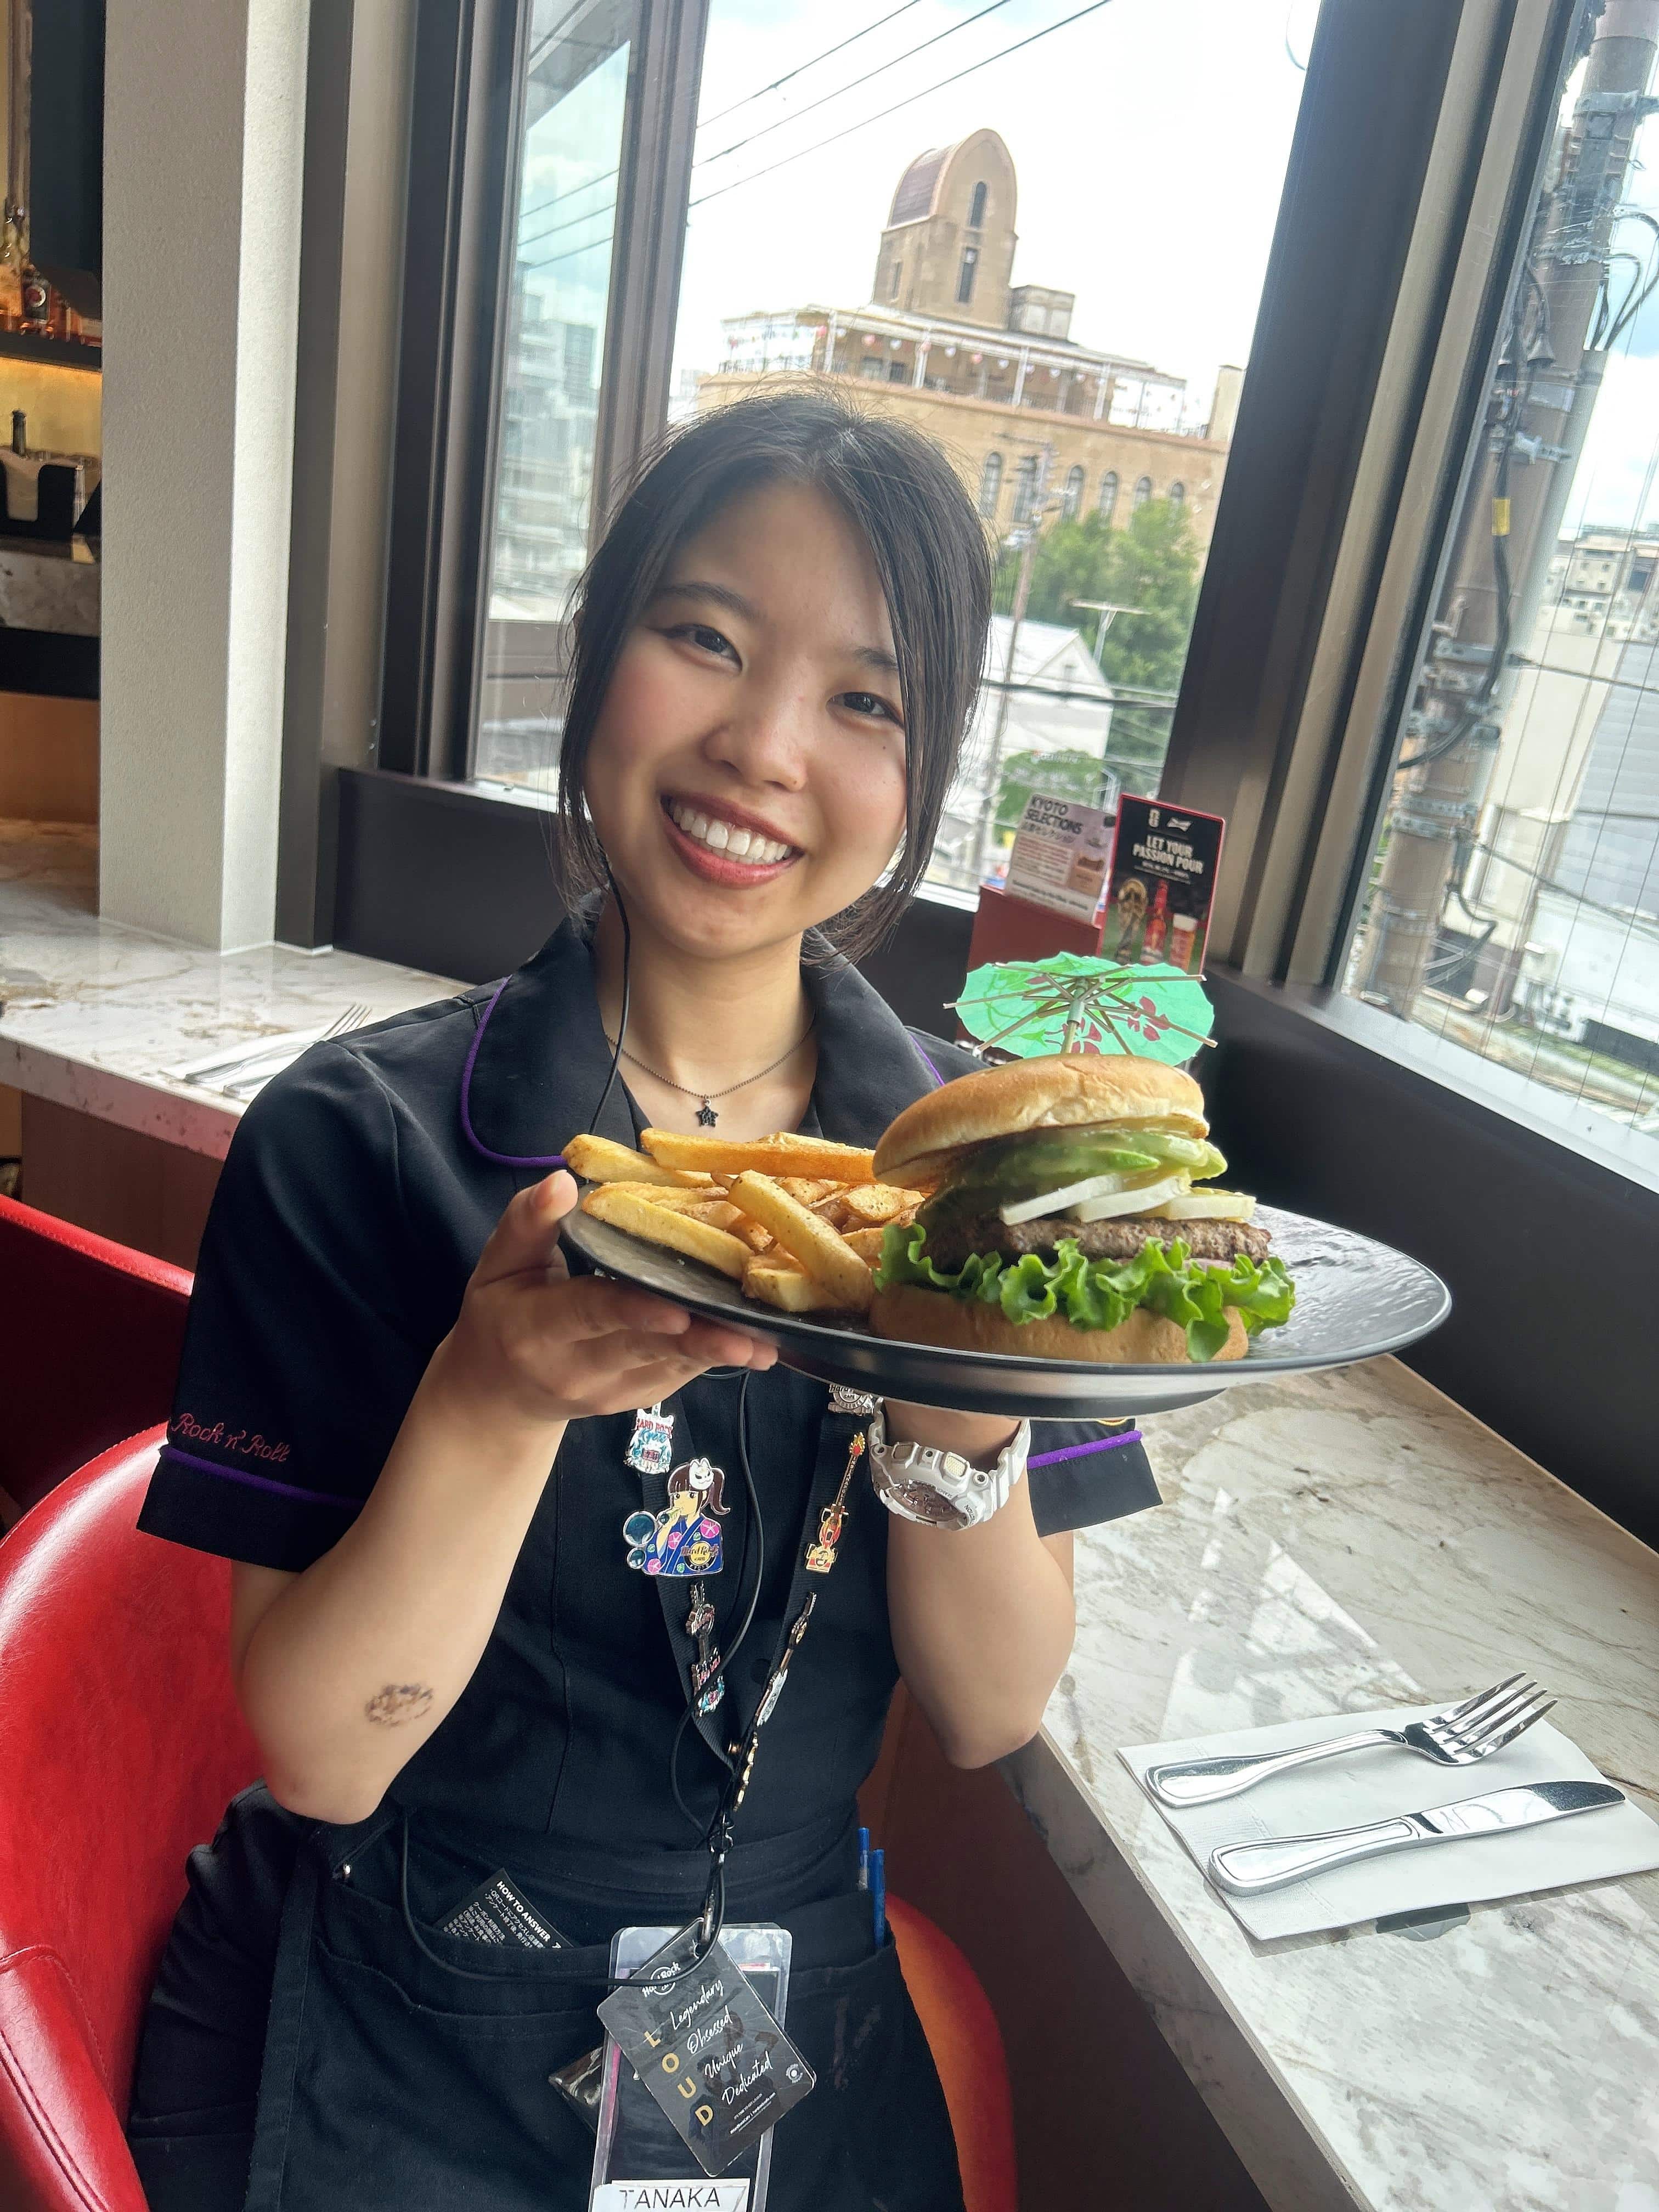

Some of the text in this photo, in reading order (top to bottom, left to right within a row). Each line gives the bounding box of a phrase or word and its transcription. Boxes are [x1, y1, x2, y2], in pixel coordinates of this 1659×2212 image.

[1025, 808, 1084, 835] SELECTIONS
[1031, 797, 1069, 816] KYOTO
[1132, 843, 1175, 866] PASSION
[1175, 856, 1204, 874] POUR
[1146, 834, 1194, 859] LET YOUR
[171, 1413, 224, 1444] Rock
[242, 1435, 290, 1462] Roll
[635, 1418, 653, 1431] HARD
[496, 1881, 516, 1901] HOW
[513, 1899, 524, 1912] TO
[521, 1912, 551, 1942] ANSWER
[670, 1979, 724, 2030] Legendary
[687, 2005, 733, 2054] Obsessed
[704, 2043, 743, 2078] Unique
[721, 2051, 774, 2105] Dedicated
[619, 2187, 720, 2210] TANAKA
